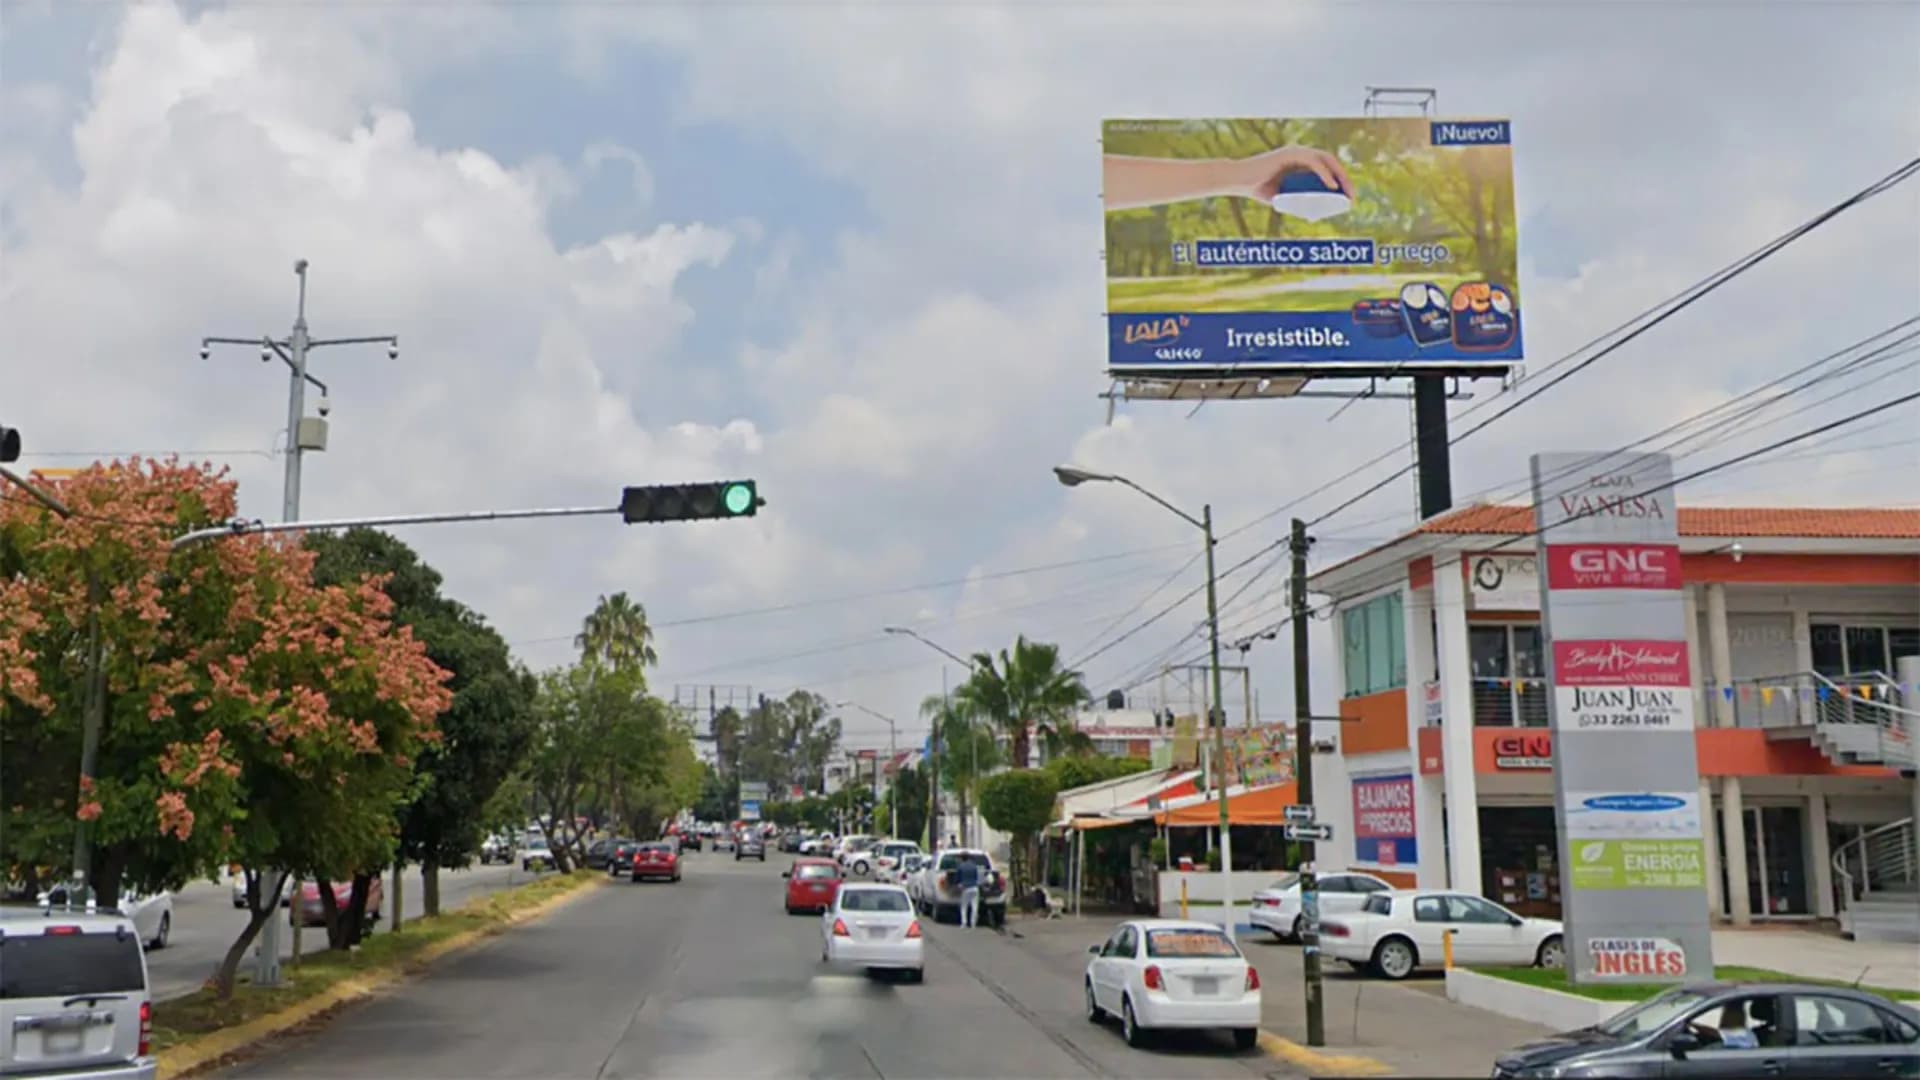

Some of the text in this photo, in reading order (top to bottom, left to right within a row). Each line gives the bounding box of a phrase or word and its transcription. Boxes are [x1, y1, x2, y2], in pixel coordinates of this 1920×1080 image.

[1436, 123, 1505, 145] ¡Nuevo!
[1171, 244, 1191, 263] El
[1198, 243, 1304, 263] auténtico
[1308, 242, 1370, 262] sabor
[1124, 317, 1180, 344] LALA
[1226, 327, 1352, 350] Irresistible.
[1558, 495, 1664, 520] VANESA
[1569, 549, 1668, 573] GNC
[1571, 687, 1674, 712] JUAN JUAN
[1592, 714, 1608, 725] 33
[1496, 736, 1551, 757] GN
[1358, 784, 1411, 808] BAJAMOS
[1370, 811, 1413, 833] PRECIOS
[1591, 940, 1656, 951] CLASES DE
